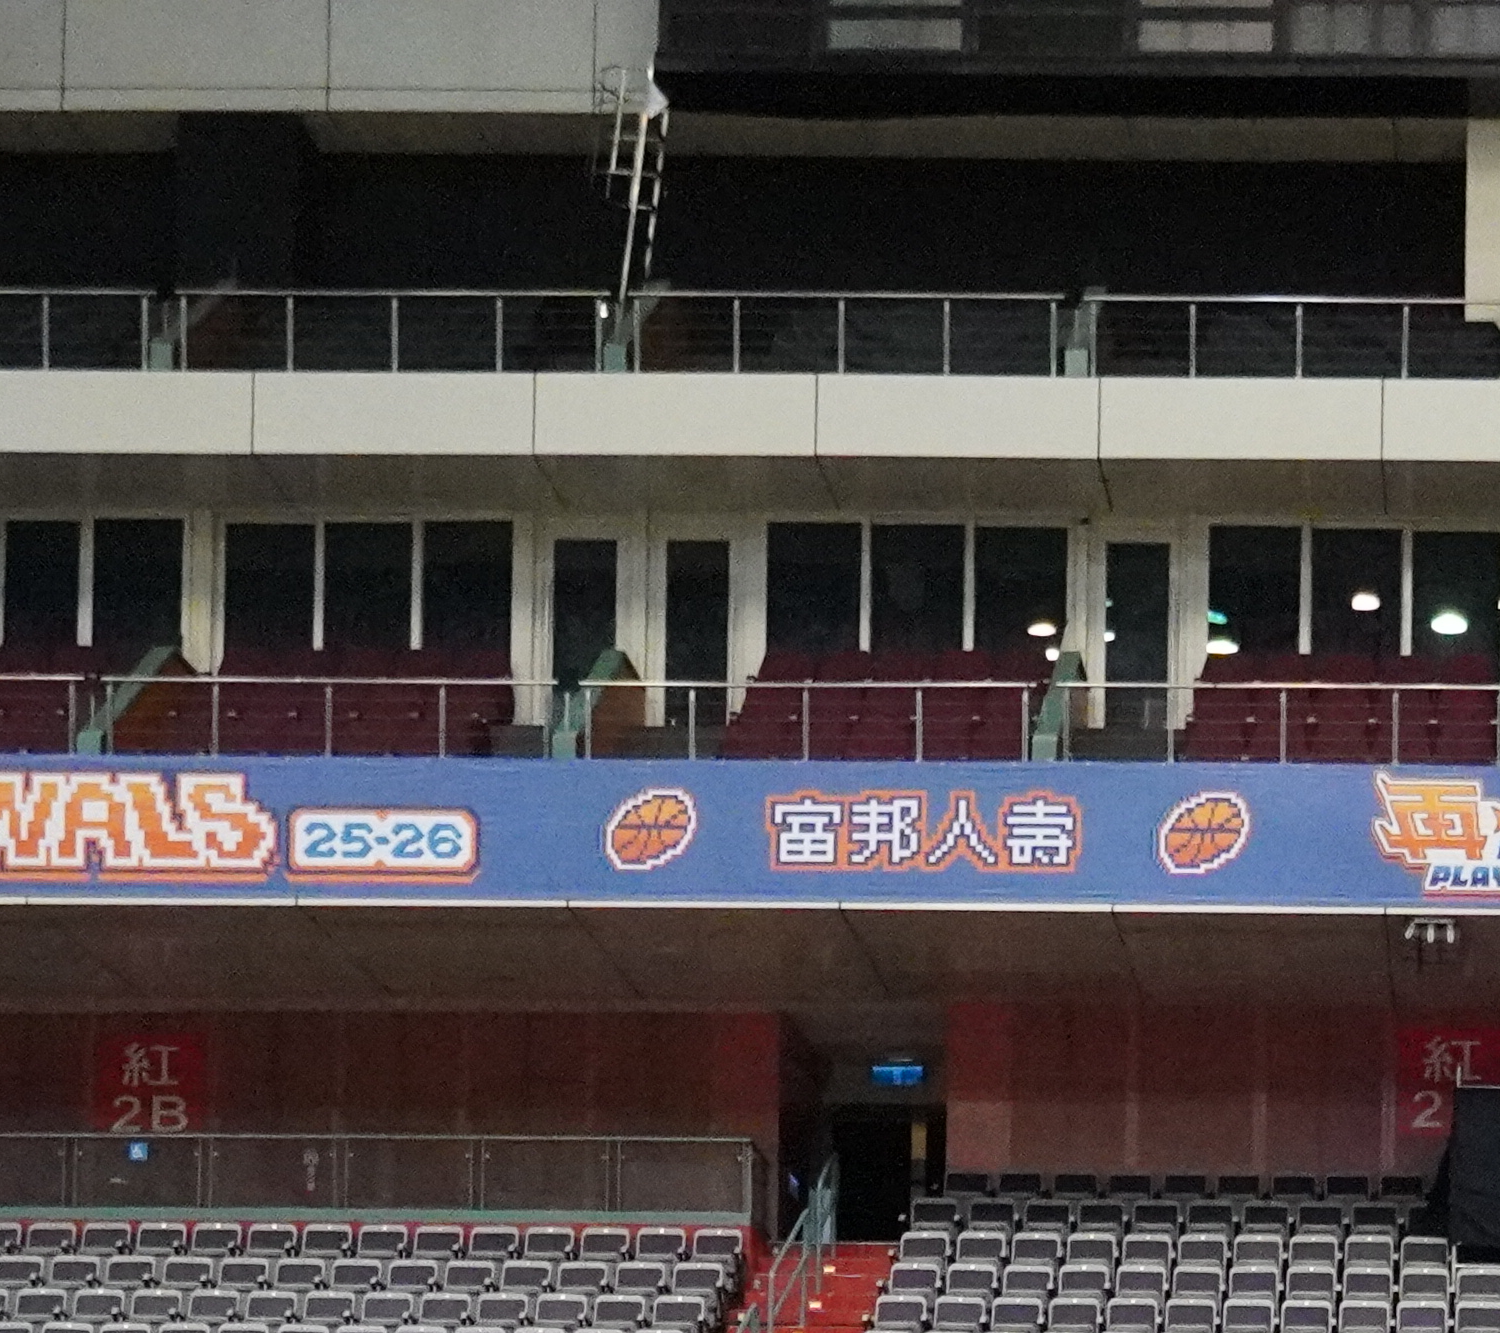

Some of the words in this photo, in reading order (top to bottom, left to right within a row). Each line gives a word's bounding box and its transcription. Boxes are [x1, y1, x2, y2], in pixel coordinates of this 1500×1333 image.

[303, 821, 464, 859] 25-26
[772, 797, 1076, 867] 富邦人壽
[122, 1043, 178, 1087] 紅
[1422, 1036, 1481, 1083] 紅
[111, 1095, 189, 1133] 2B
